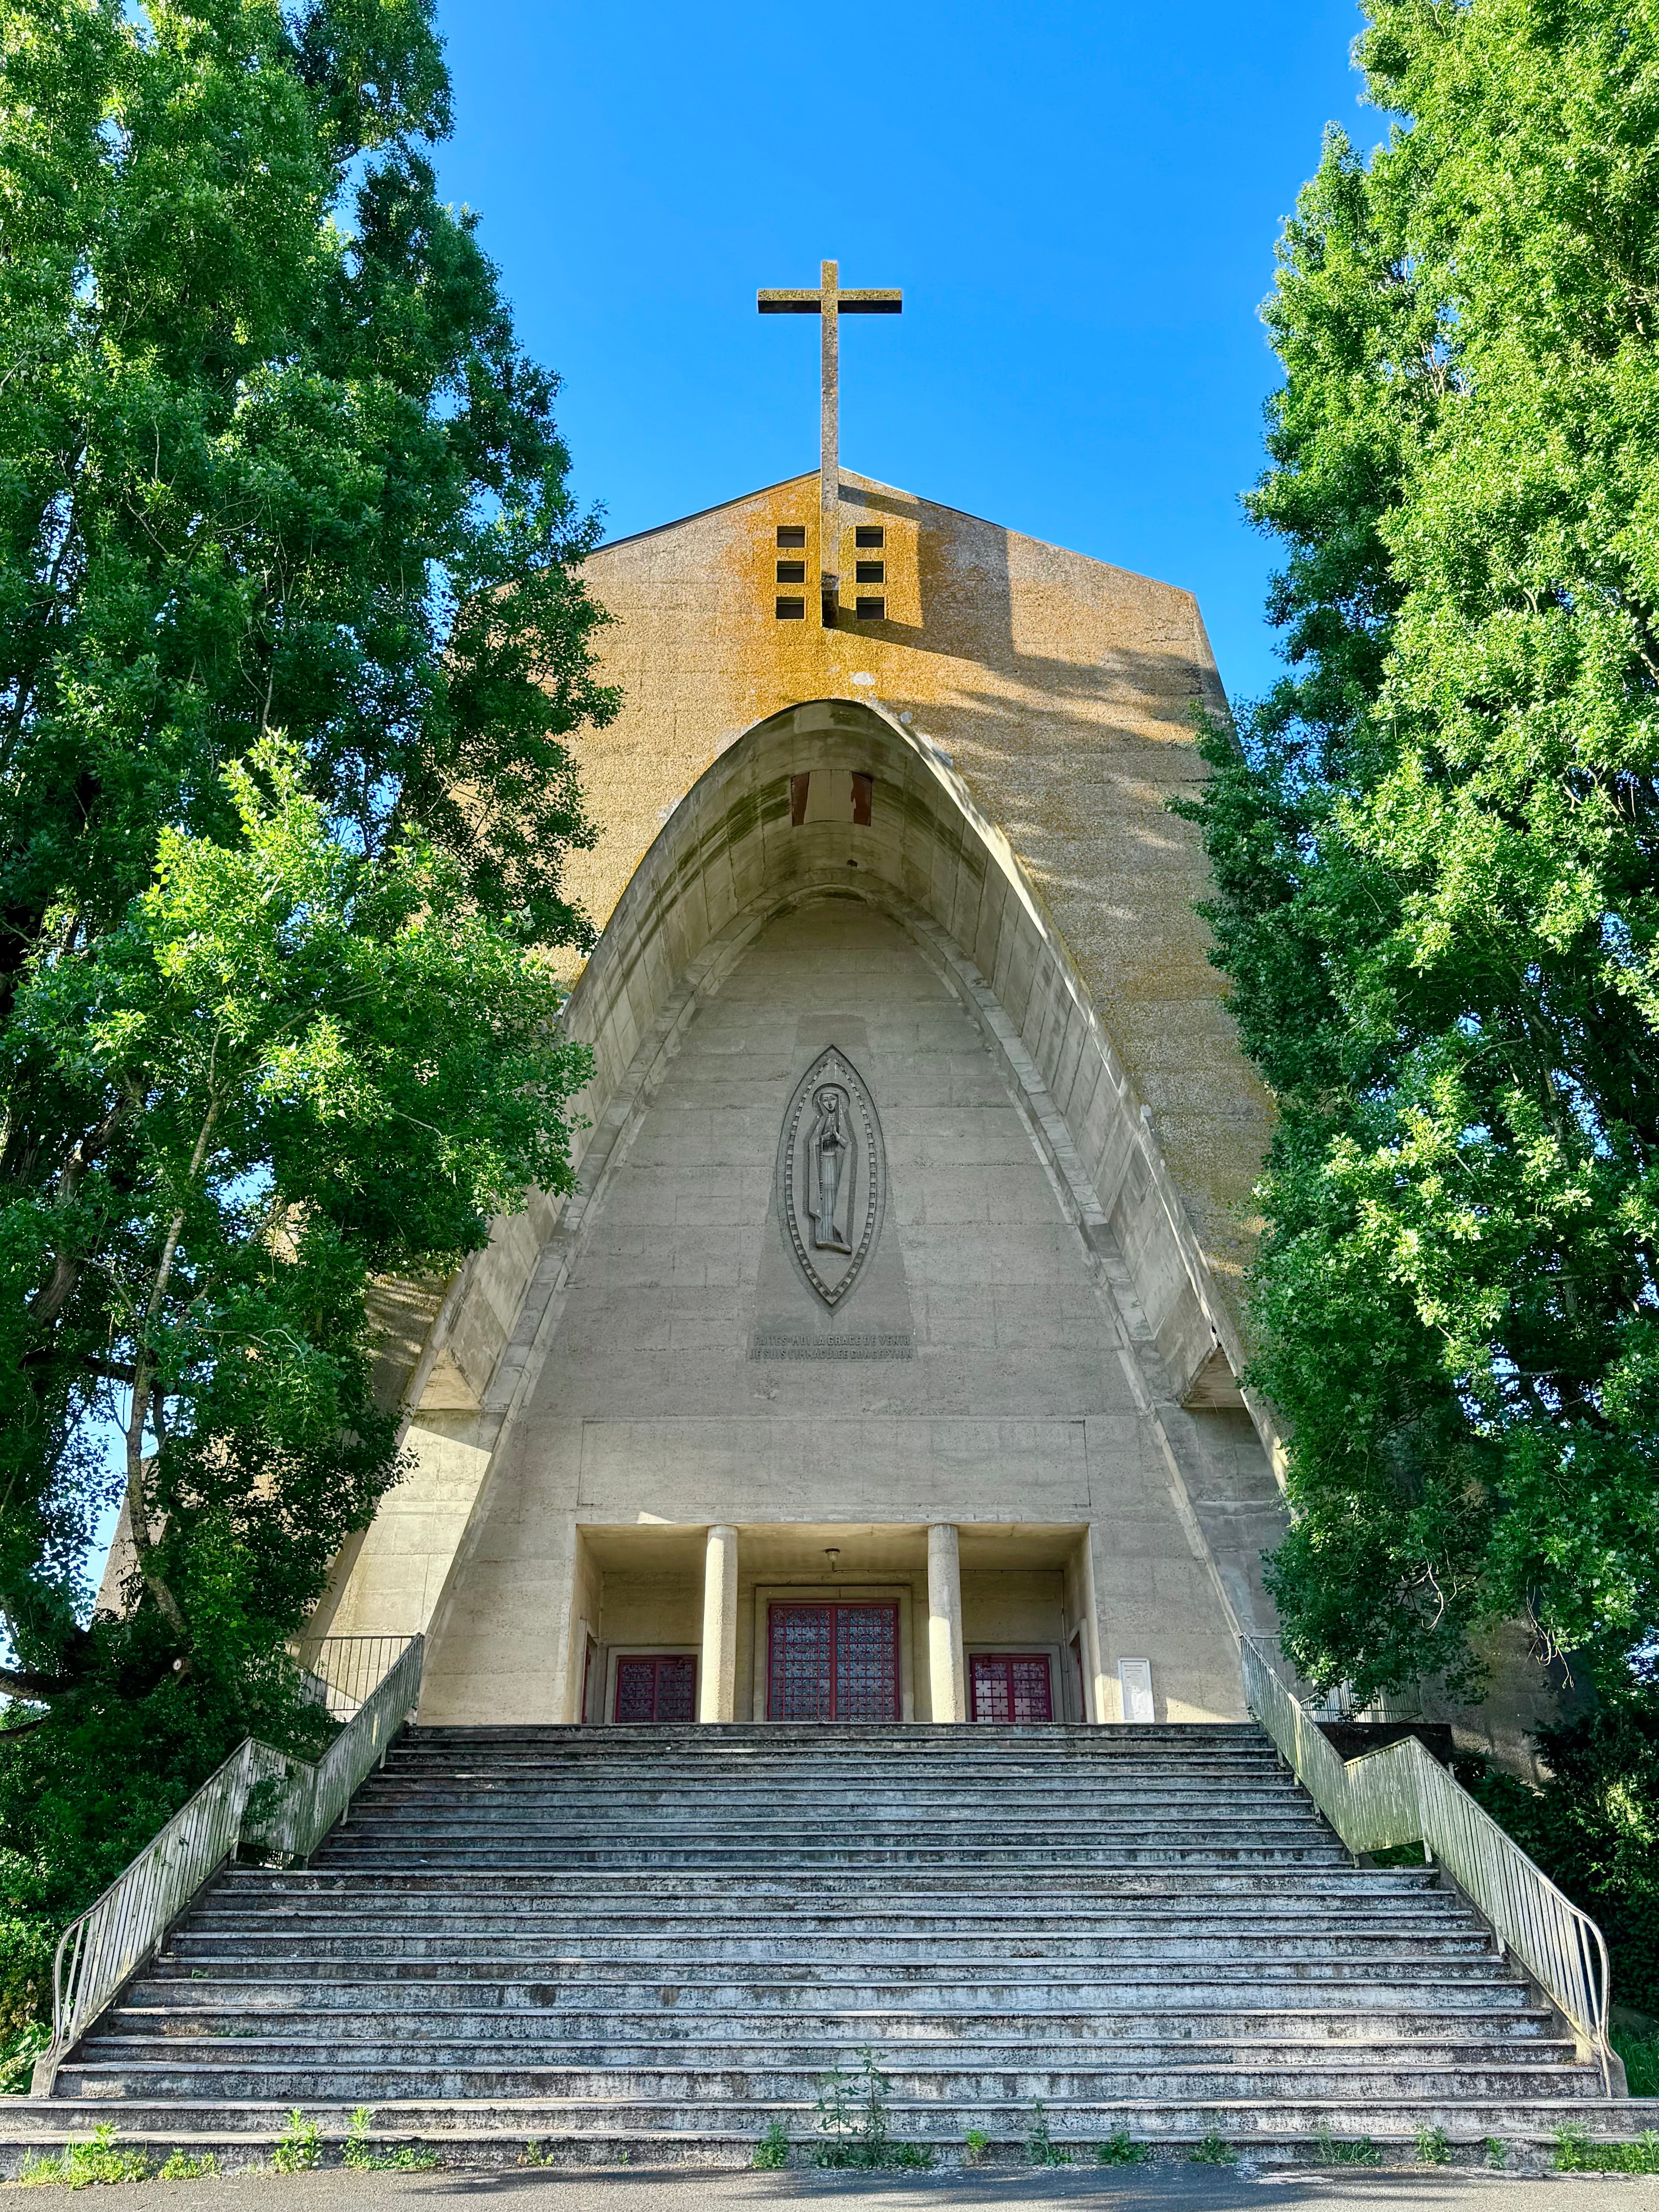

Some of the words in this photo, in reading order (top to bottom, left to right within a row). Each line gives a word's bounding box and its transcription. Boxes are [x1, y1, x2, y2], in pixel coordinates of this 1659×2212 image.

[813, 1336, 825, 1346] LA
[863, 1336, 876, 1346] DE
[878, 1336, 910, 1346] VENIR
[750, 1349, 761, 1360] JE
[763, 1349, 786, 1360] SUIS
[850, 1349, 913, 1360] CONCEPTION
